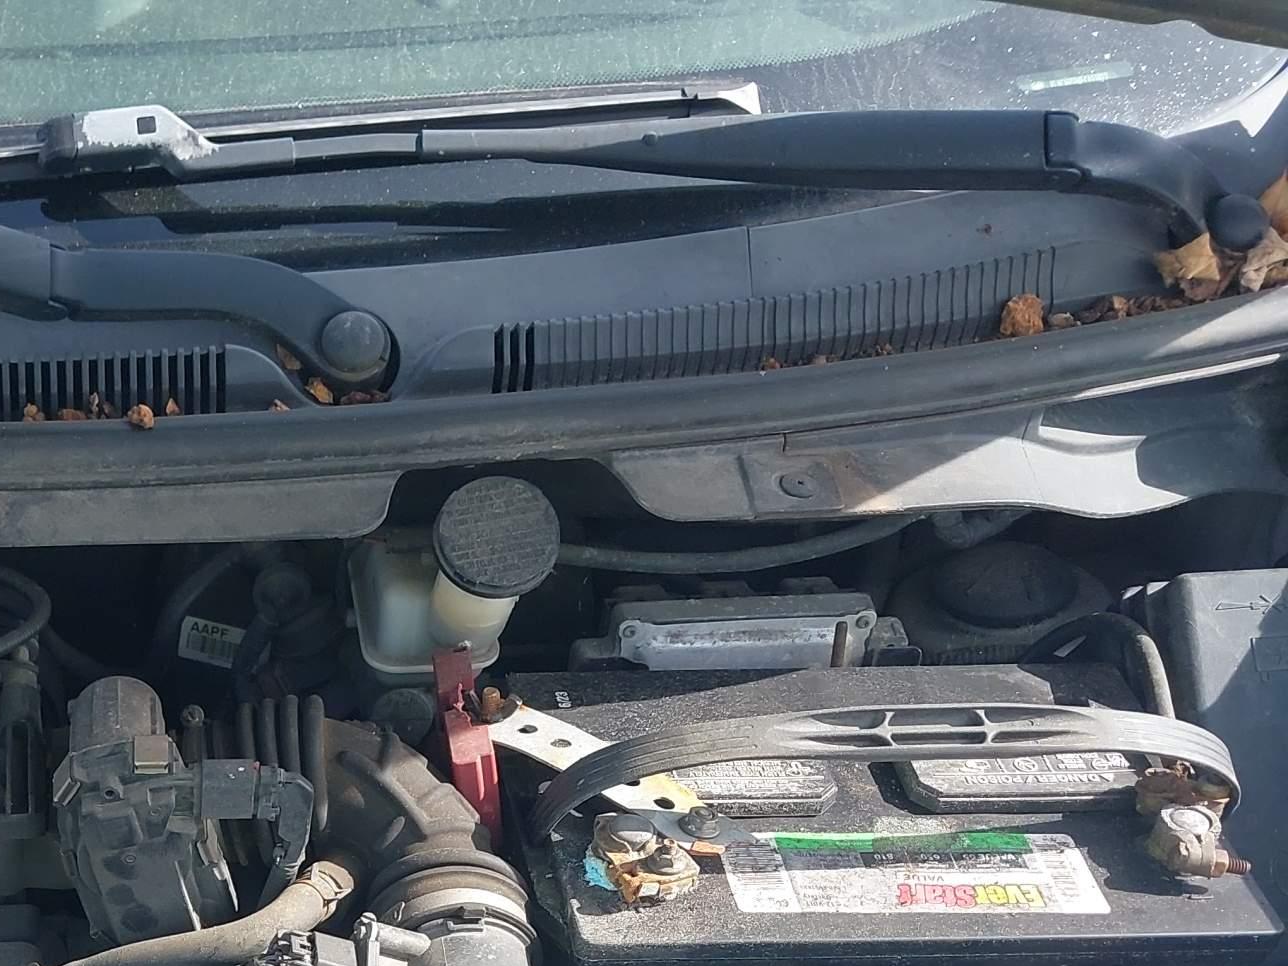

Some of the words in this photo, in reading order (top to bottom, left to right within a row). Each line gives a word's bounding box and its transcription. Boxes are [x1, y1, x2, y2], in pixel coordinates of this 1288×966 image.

[554, 691, 572, 708] 6/23
[903, 874, 944, 882] VALUE
[896, 882, 1048, 909] EverStart
